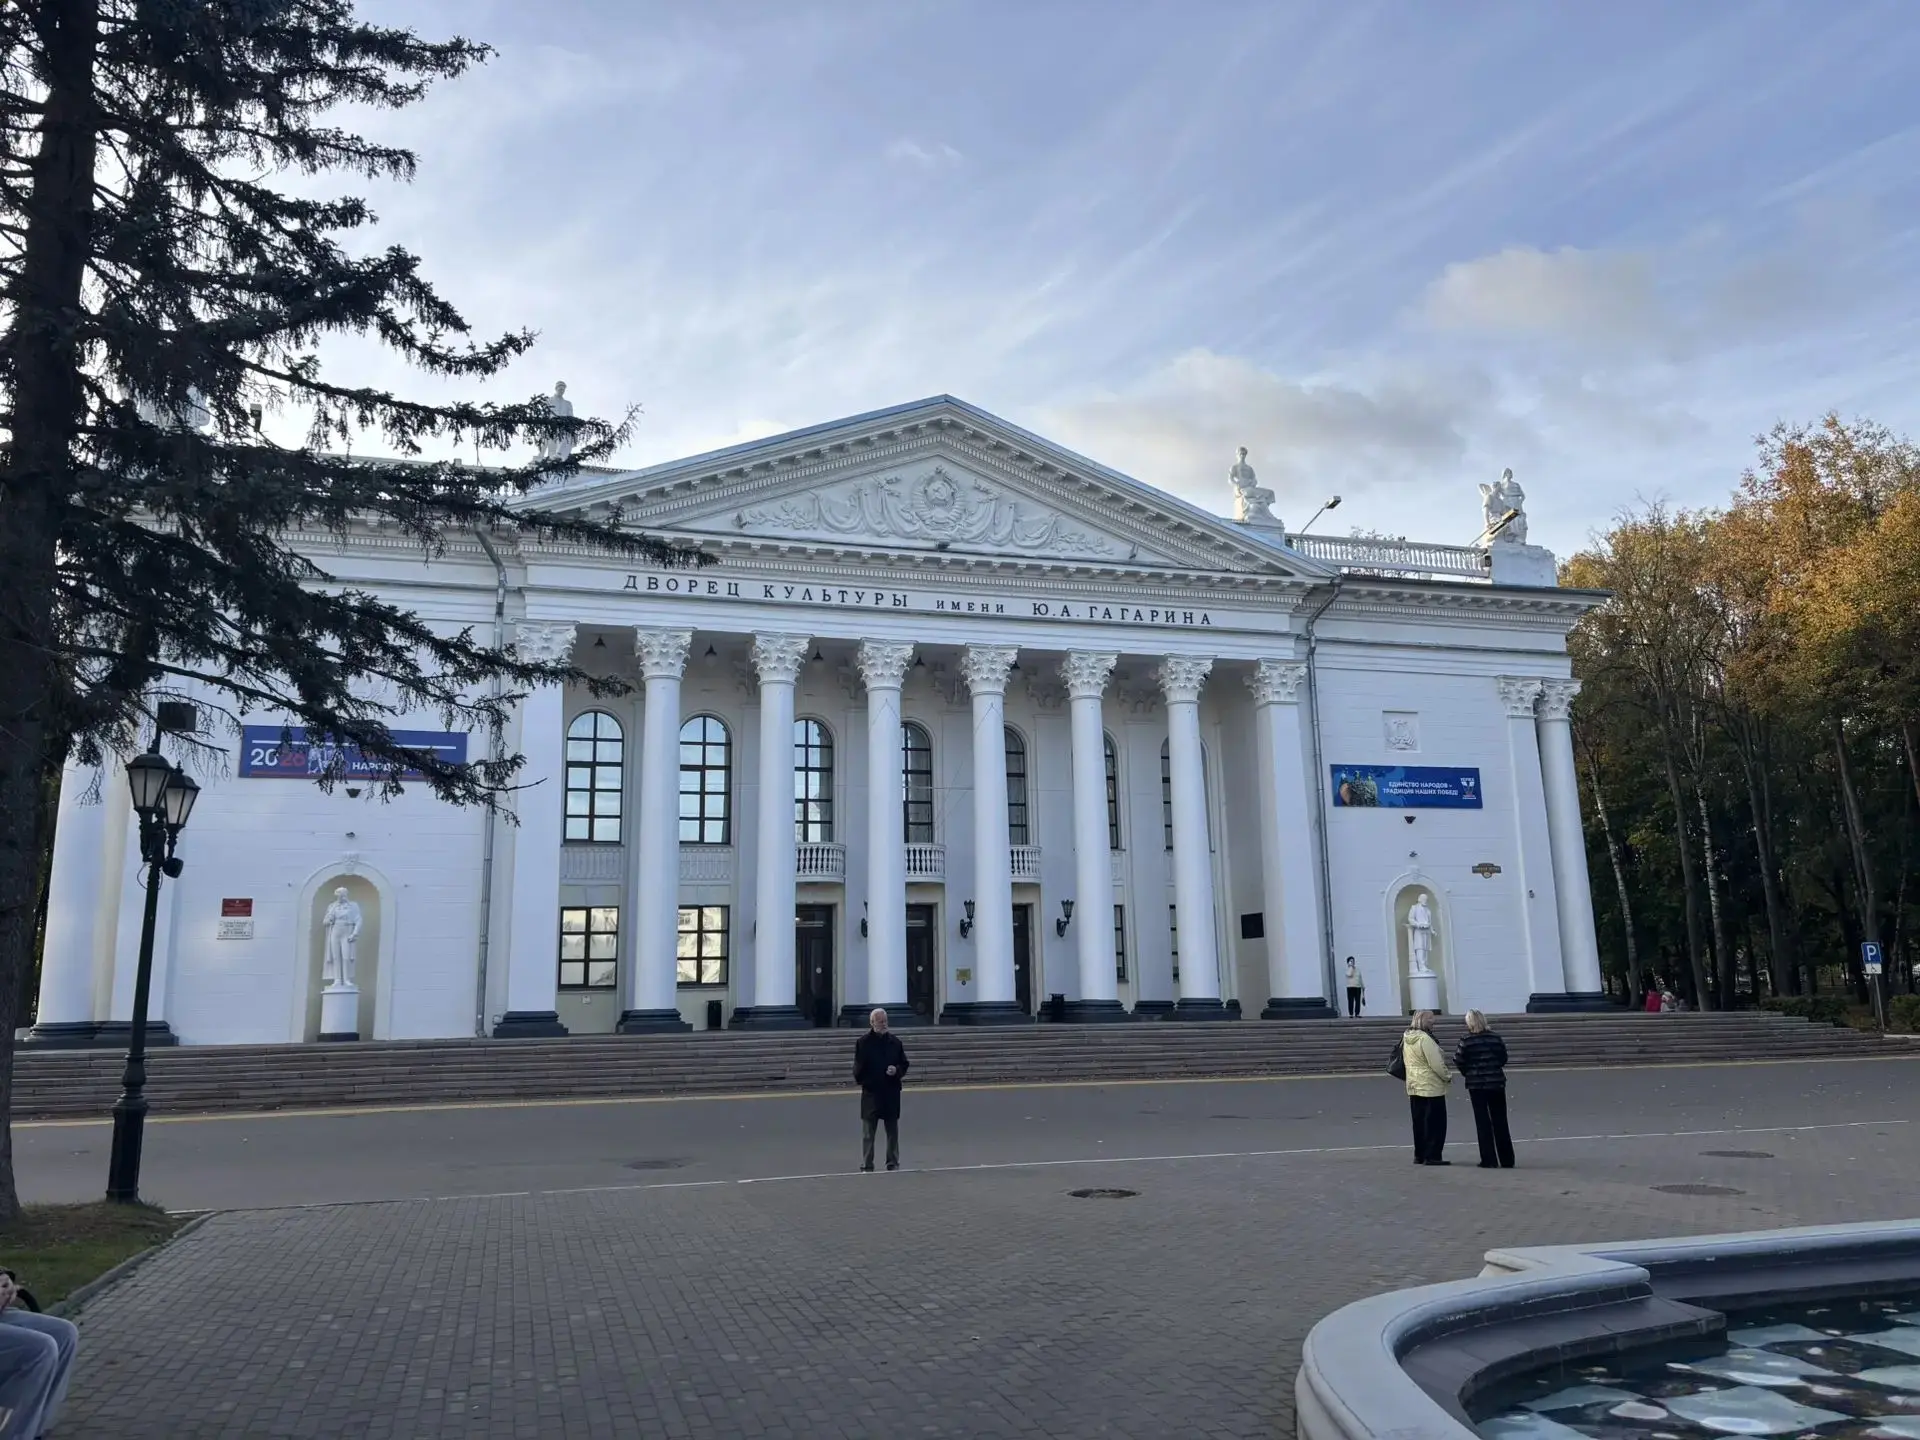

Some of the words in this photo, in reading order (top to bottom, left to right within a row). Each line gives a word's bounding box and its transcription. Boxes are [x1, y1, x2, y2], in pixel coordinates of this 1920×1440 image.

[624, 575, 740, 598] ДВОРЕЦ
[763, 584, 908, 608] КУЛЬТУРЫ
[936, 600, 1005, 613] ИМЕНИ
[1088, 606, 1212, 625] ГАГАРИНА
[1382, 787, 1414, 795] ТРАДИЦИЯ
[1866, 945, 1877, 961] P
